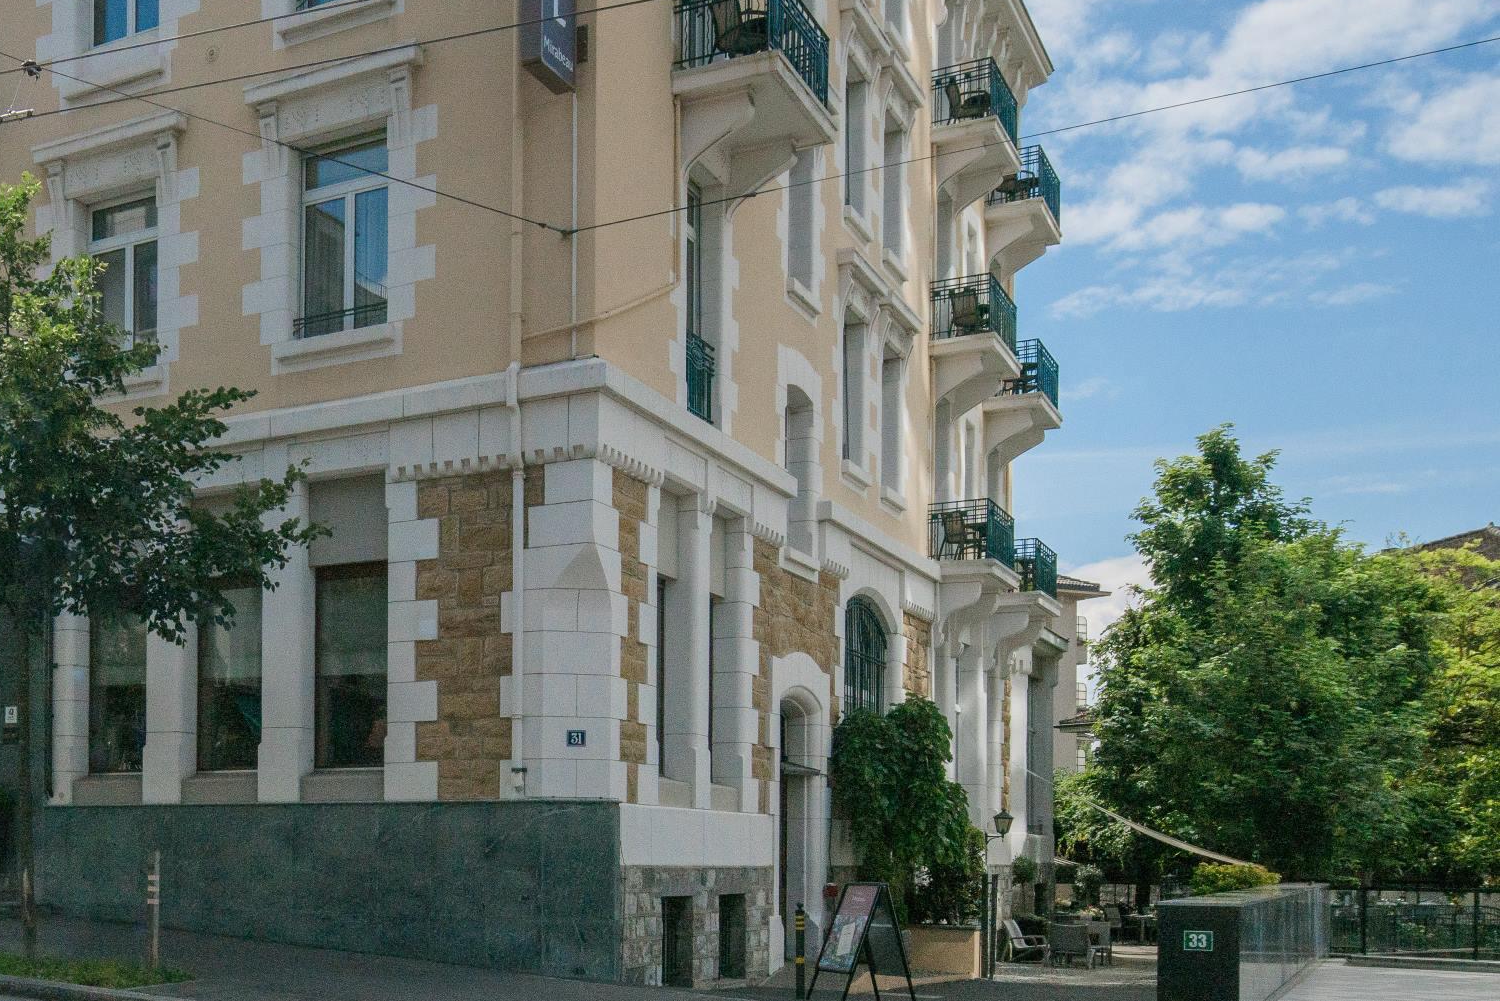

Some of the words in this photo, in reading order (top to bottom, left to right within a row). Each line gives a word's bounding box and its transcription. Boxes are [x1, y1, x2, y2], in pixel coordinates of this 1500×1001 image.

[544, 35, 573, 72] Mirabeau
[570, 732, 582, 745] 31
[1188, 933, 1207, 948] 33
